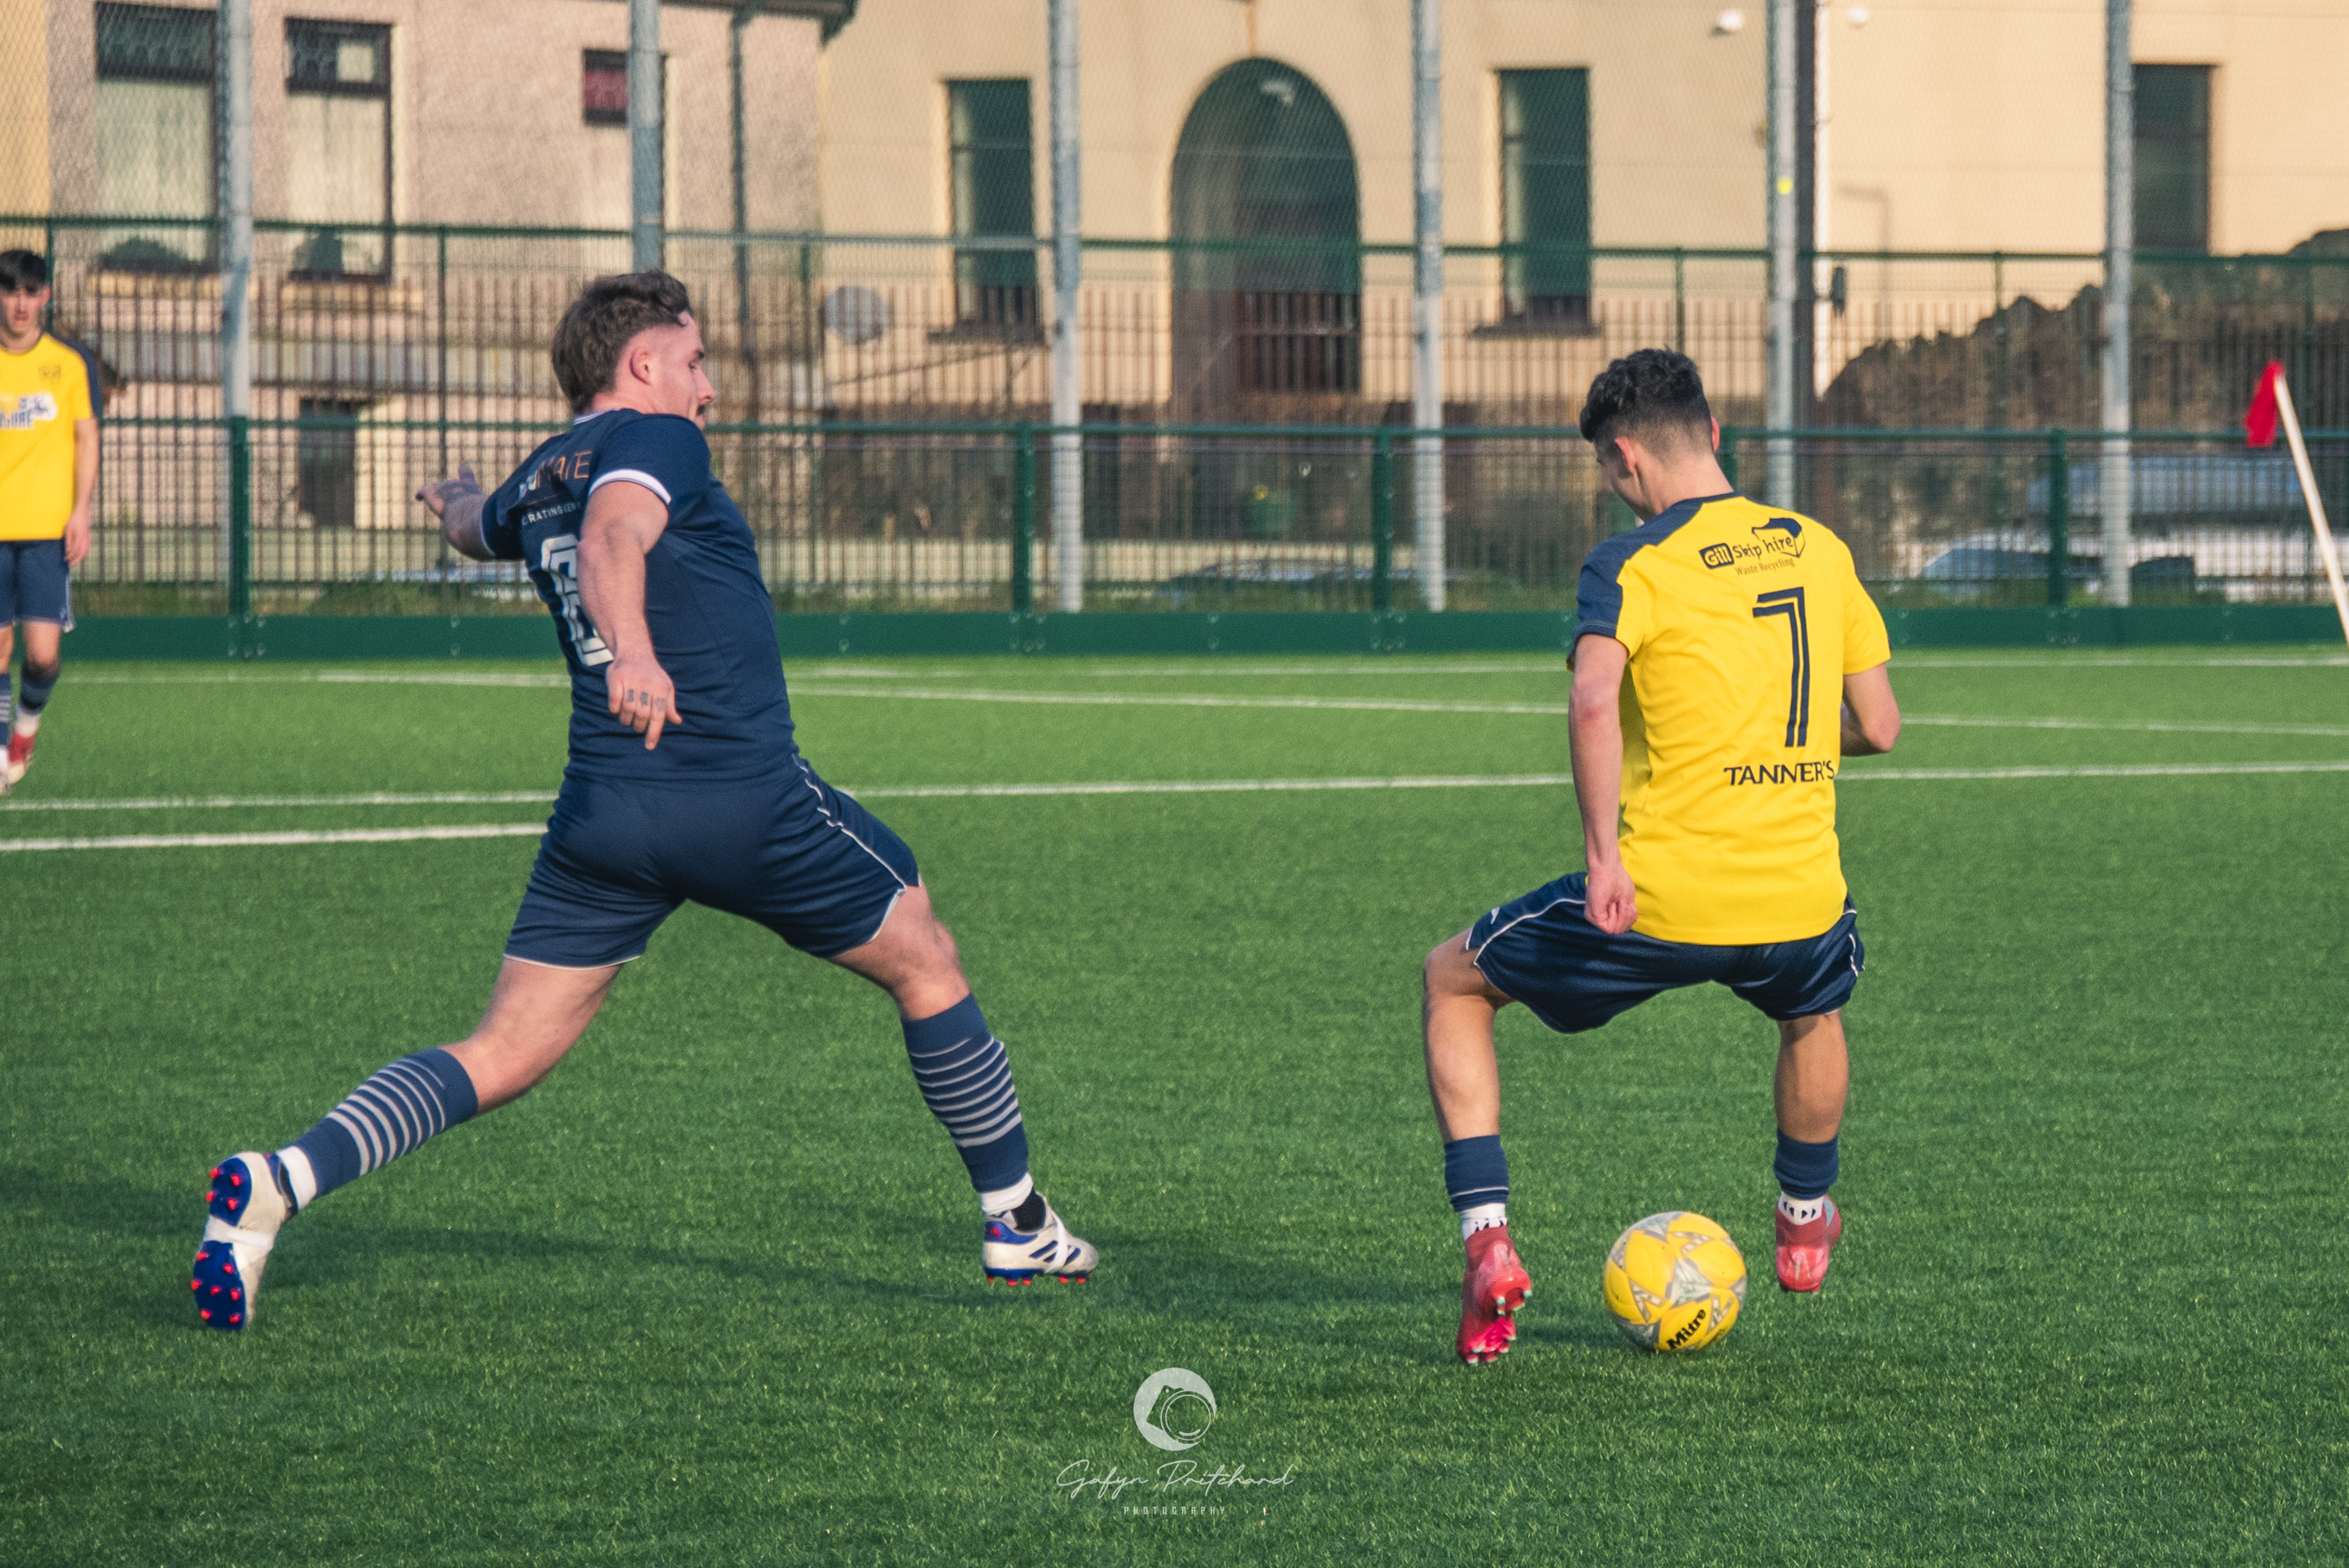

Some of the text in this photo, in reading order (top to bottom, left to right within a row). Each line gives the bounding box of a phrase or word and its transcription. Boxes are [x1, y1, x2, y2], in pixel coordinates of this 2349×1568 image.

[1702, 536, 1793, 567] Gill Skip hire
[1735, 558, 1795, 576] Waste Recycling
[1753, 586, 1810, 748] 7
[1724, 760, 1835, 785] TANNER'S
